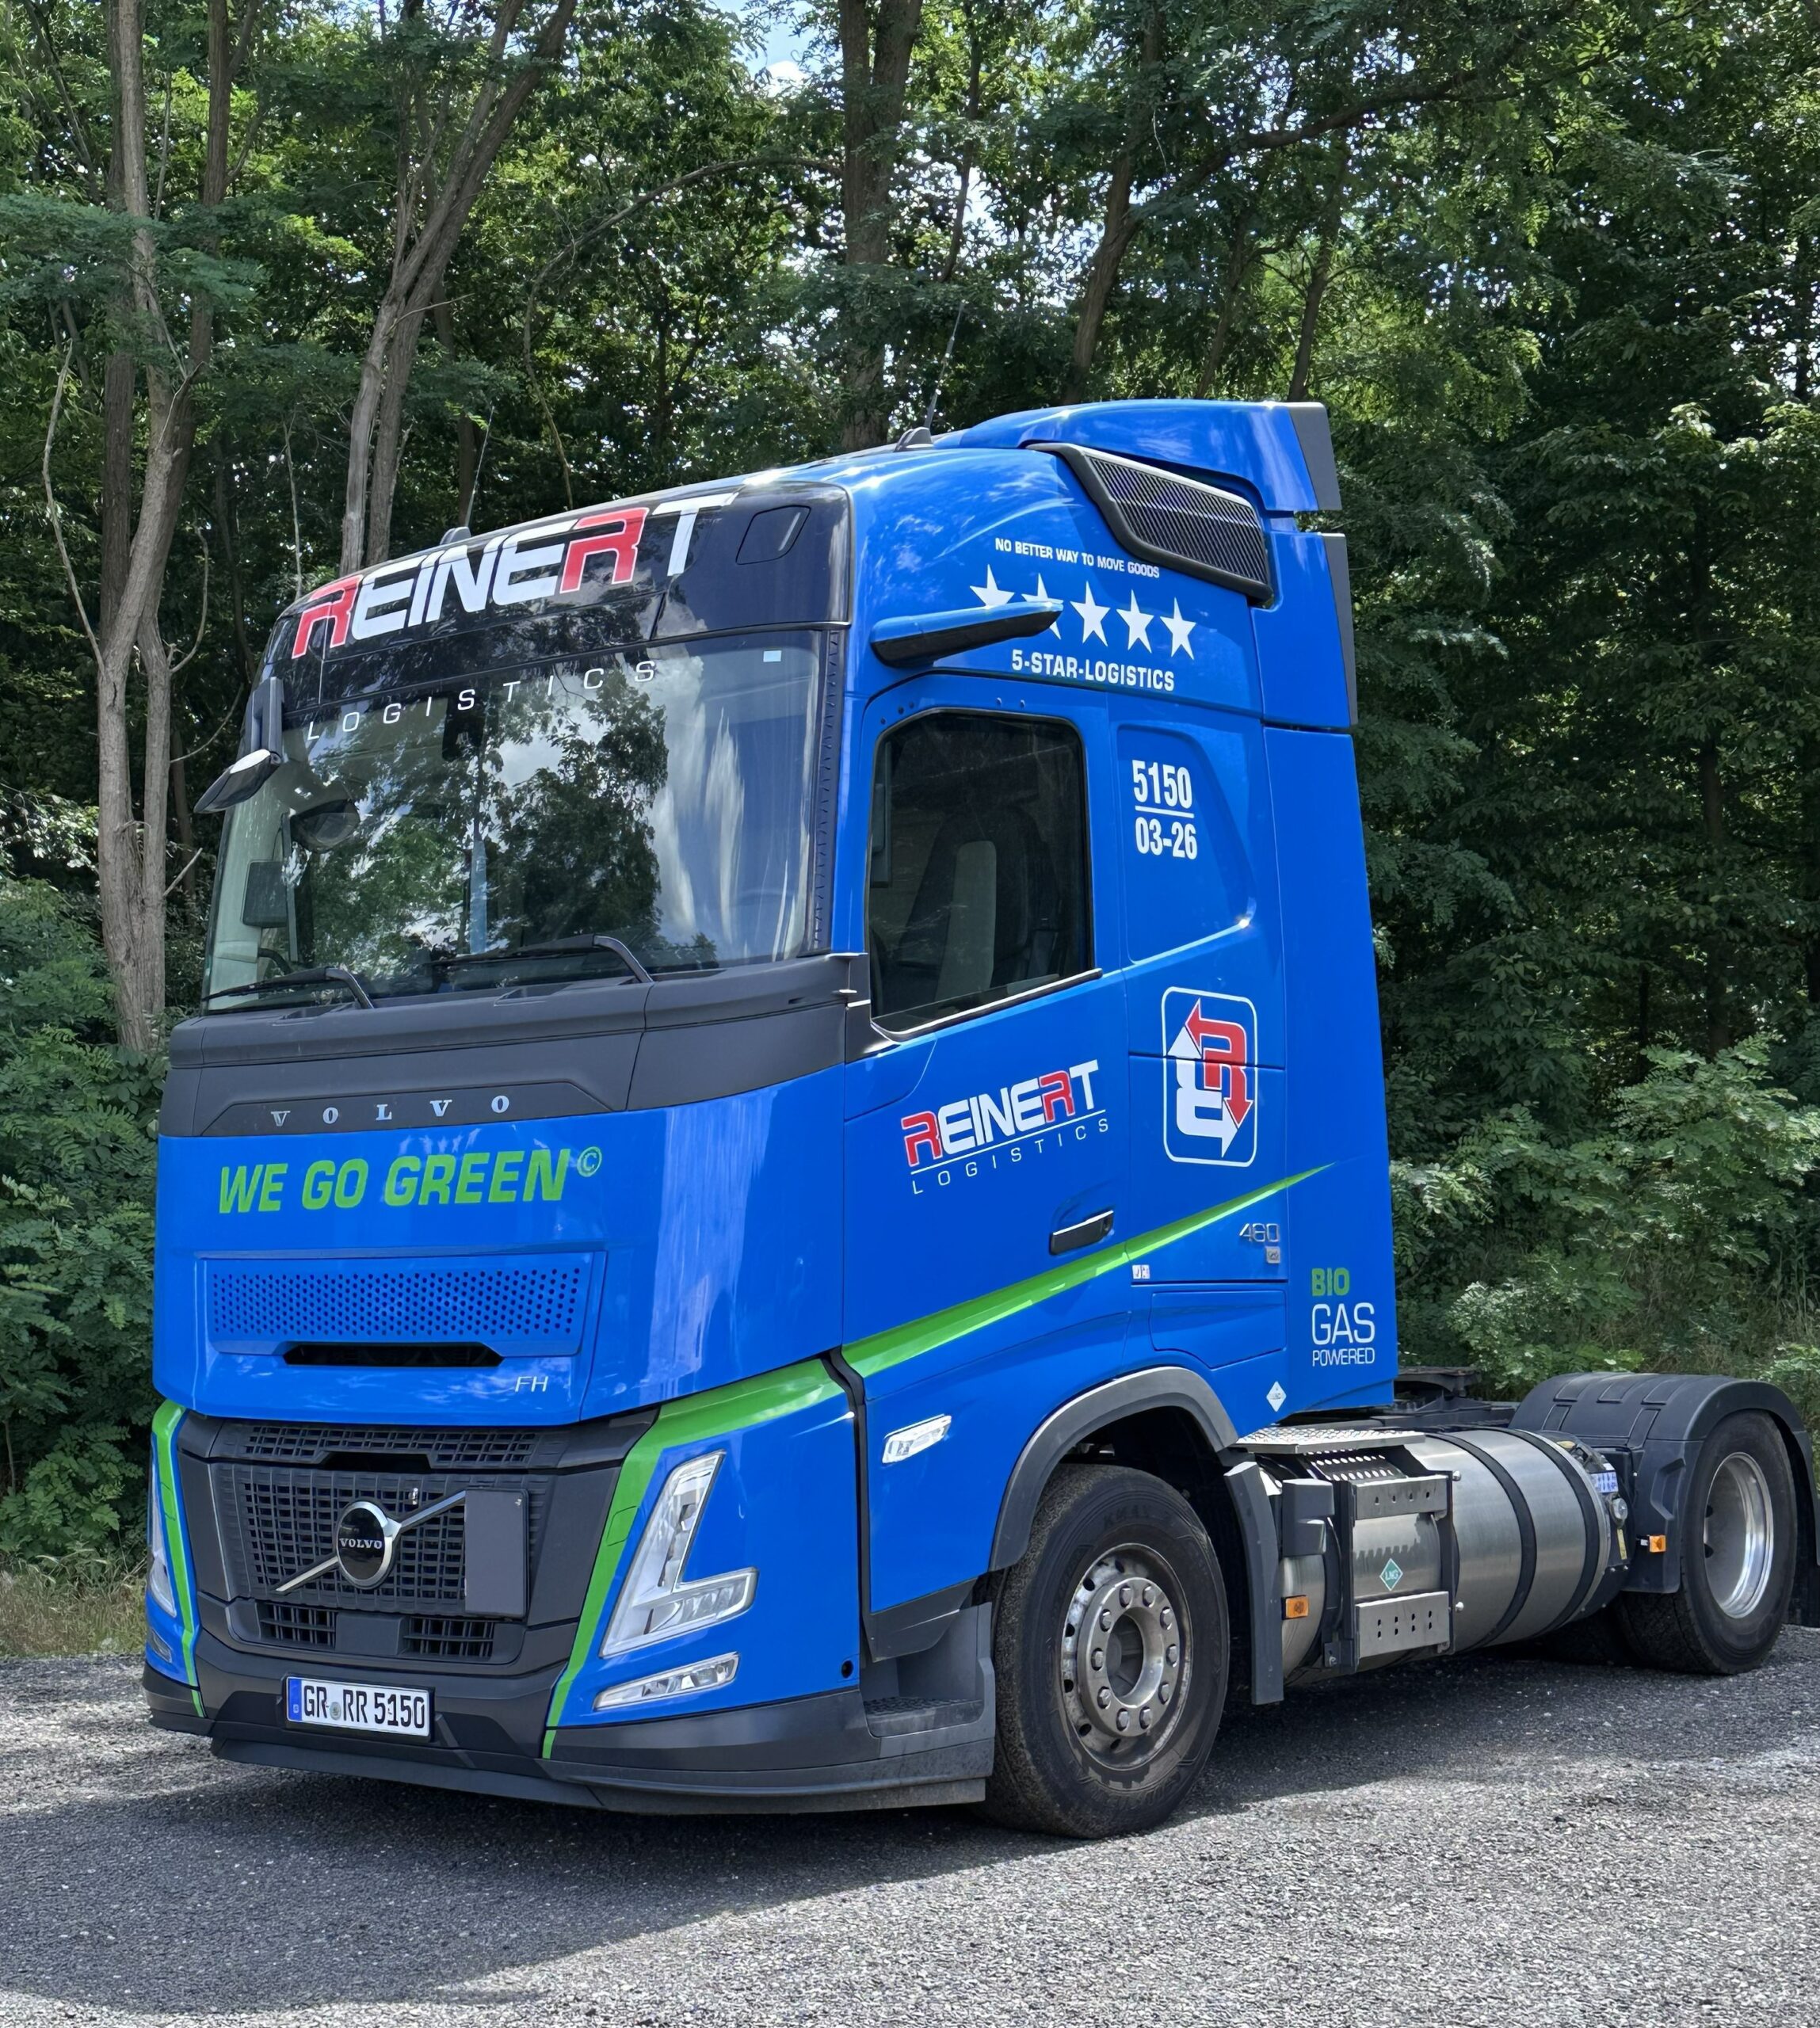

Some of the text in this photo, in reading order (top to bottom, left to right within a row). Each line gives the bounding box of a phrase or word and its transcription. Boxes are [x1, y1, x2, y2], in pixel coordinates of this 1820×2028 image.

[292, 493, 738, 659] REINERT
[995, 538, 1159, 578] NO BETTER WAY TO MOVE GOODS
[1011, 649, 1174, 692] 5-STAR-LOGISTICS
[307, 661, 655, 741] LOGISTICS
[1132, 759, 1192, 809] 5150
[1135, 817, 1197, 860] 03-26
[271, 1096, 509, 1126] VOLVO
[901, 1059, 1099, 1168] REINERT
[911, 1119, 1108, 1195] LOGISTICS
[219, 1163, 288, 1214] WE
[302, 1158, 369, 1210] GO
[1238, 1223, 1280, 1242] 460
[1311, 1268, 1350, 1296] BIO
[1311, 1302, 1375, 1345] GAS
[1312, 1347, 1375, 1367] POWERED
[514, 1376, 548, 1393] FH
[339, 1538, 383, 1550] VOLVO
[303, 1685, 425, 1729] GR RR 5150
